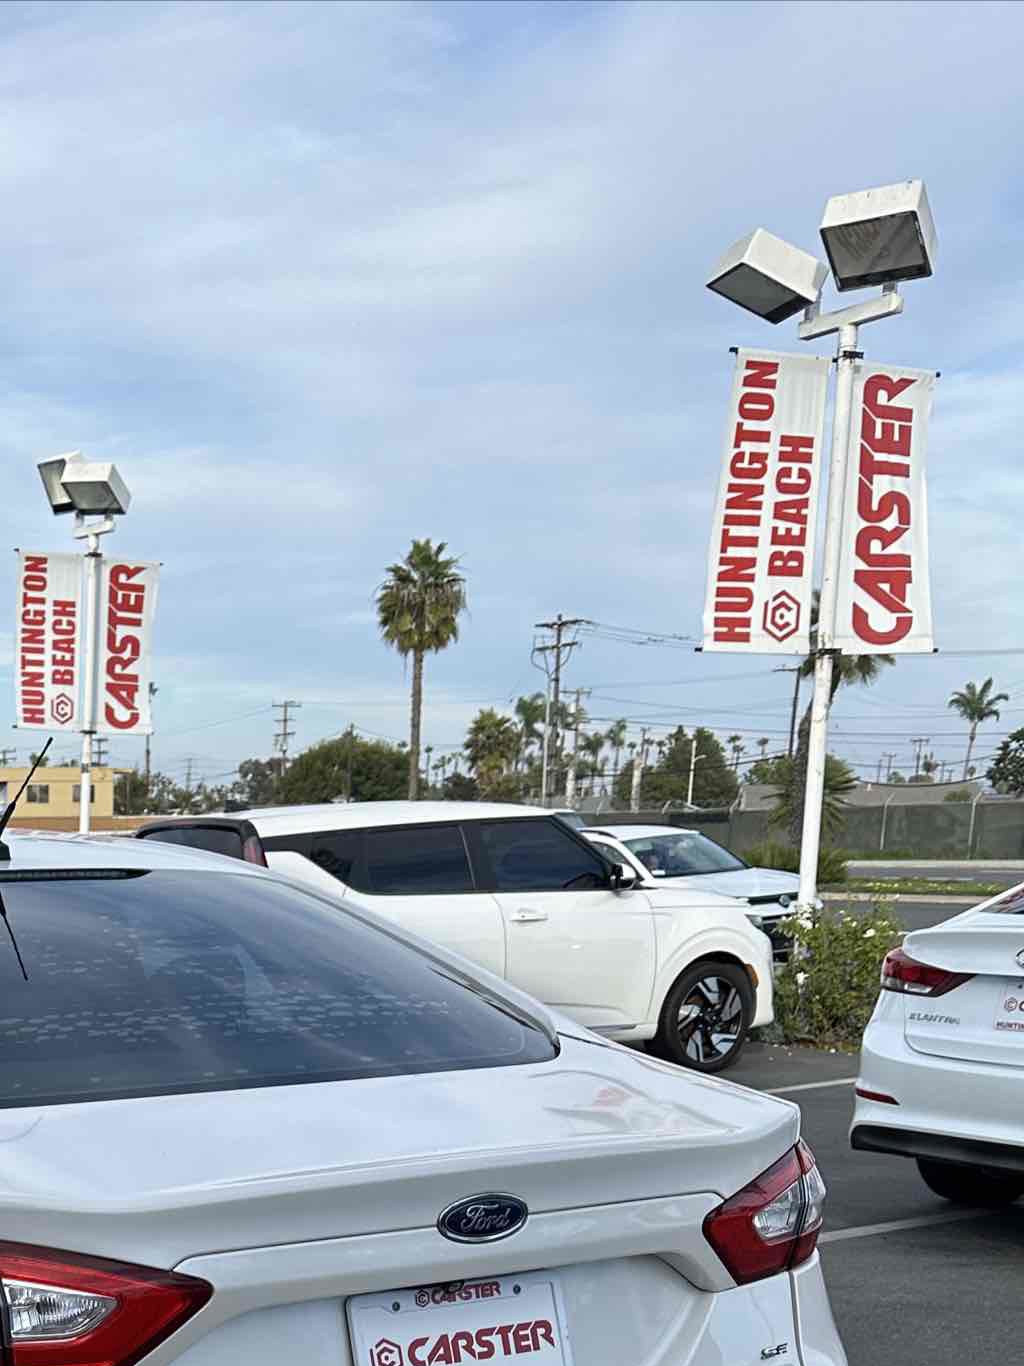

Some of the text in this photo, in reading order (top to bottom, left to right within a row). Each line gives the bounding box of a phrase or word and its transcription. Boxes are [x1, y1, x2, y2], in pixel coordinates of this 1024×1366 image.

[713, 360, 780, 643] HUNTINGTON
[767, 434, 815, 577] BEACH
[852, 373, 918, 645] CARSTER
[21, 556, 48, 724] HUNTINGTON
[51, 600, 76, 685] BEACH
[105, 564, 147, 729] CARSTER
[431, 1281, 501, 1305] CARSTER
[460, 1204, 511, 1232] Ford
